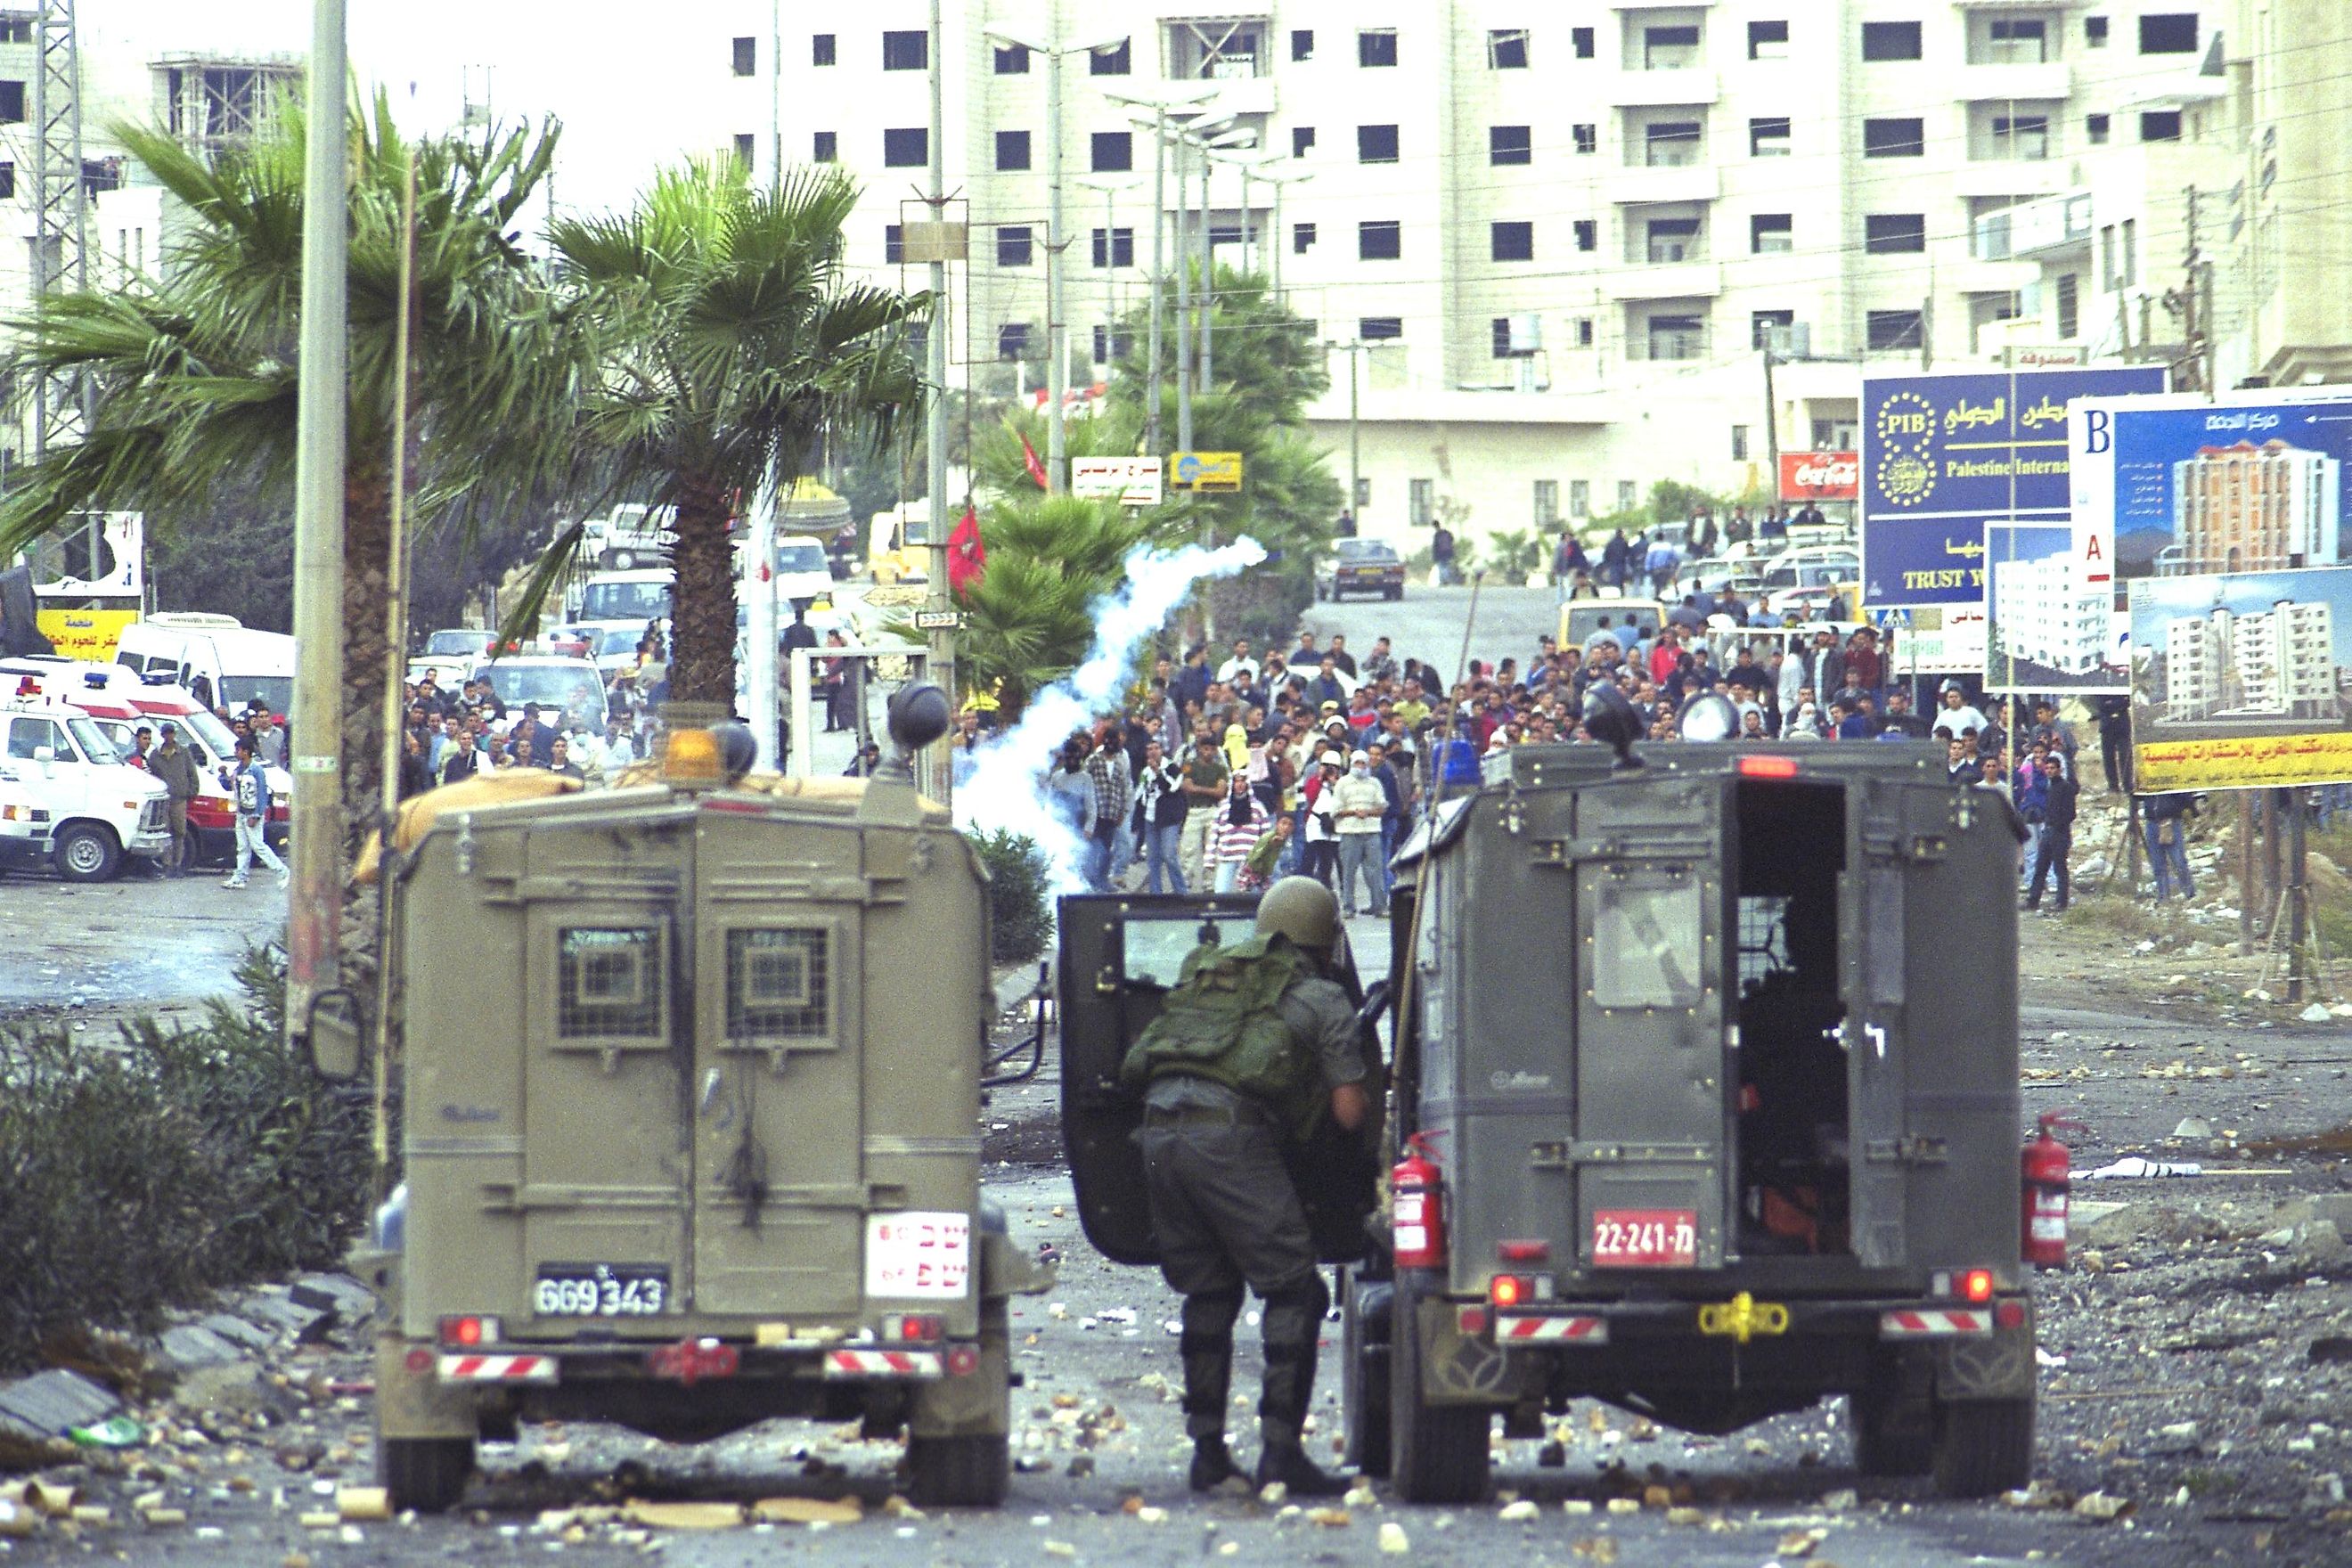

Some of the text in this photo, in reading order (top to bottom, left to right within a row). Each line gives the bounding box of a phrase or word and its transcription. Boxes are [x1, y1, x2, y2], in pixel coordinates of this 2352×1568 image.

[1887, 414, 1926, 434] PIB
[2085, 410, 2110, 453] B
[1946, 458, 2012, 478] Palestine
[2087, 535, 2102, 560] A
[1902, 569, 1965, 590] TRUST
